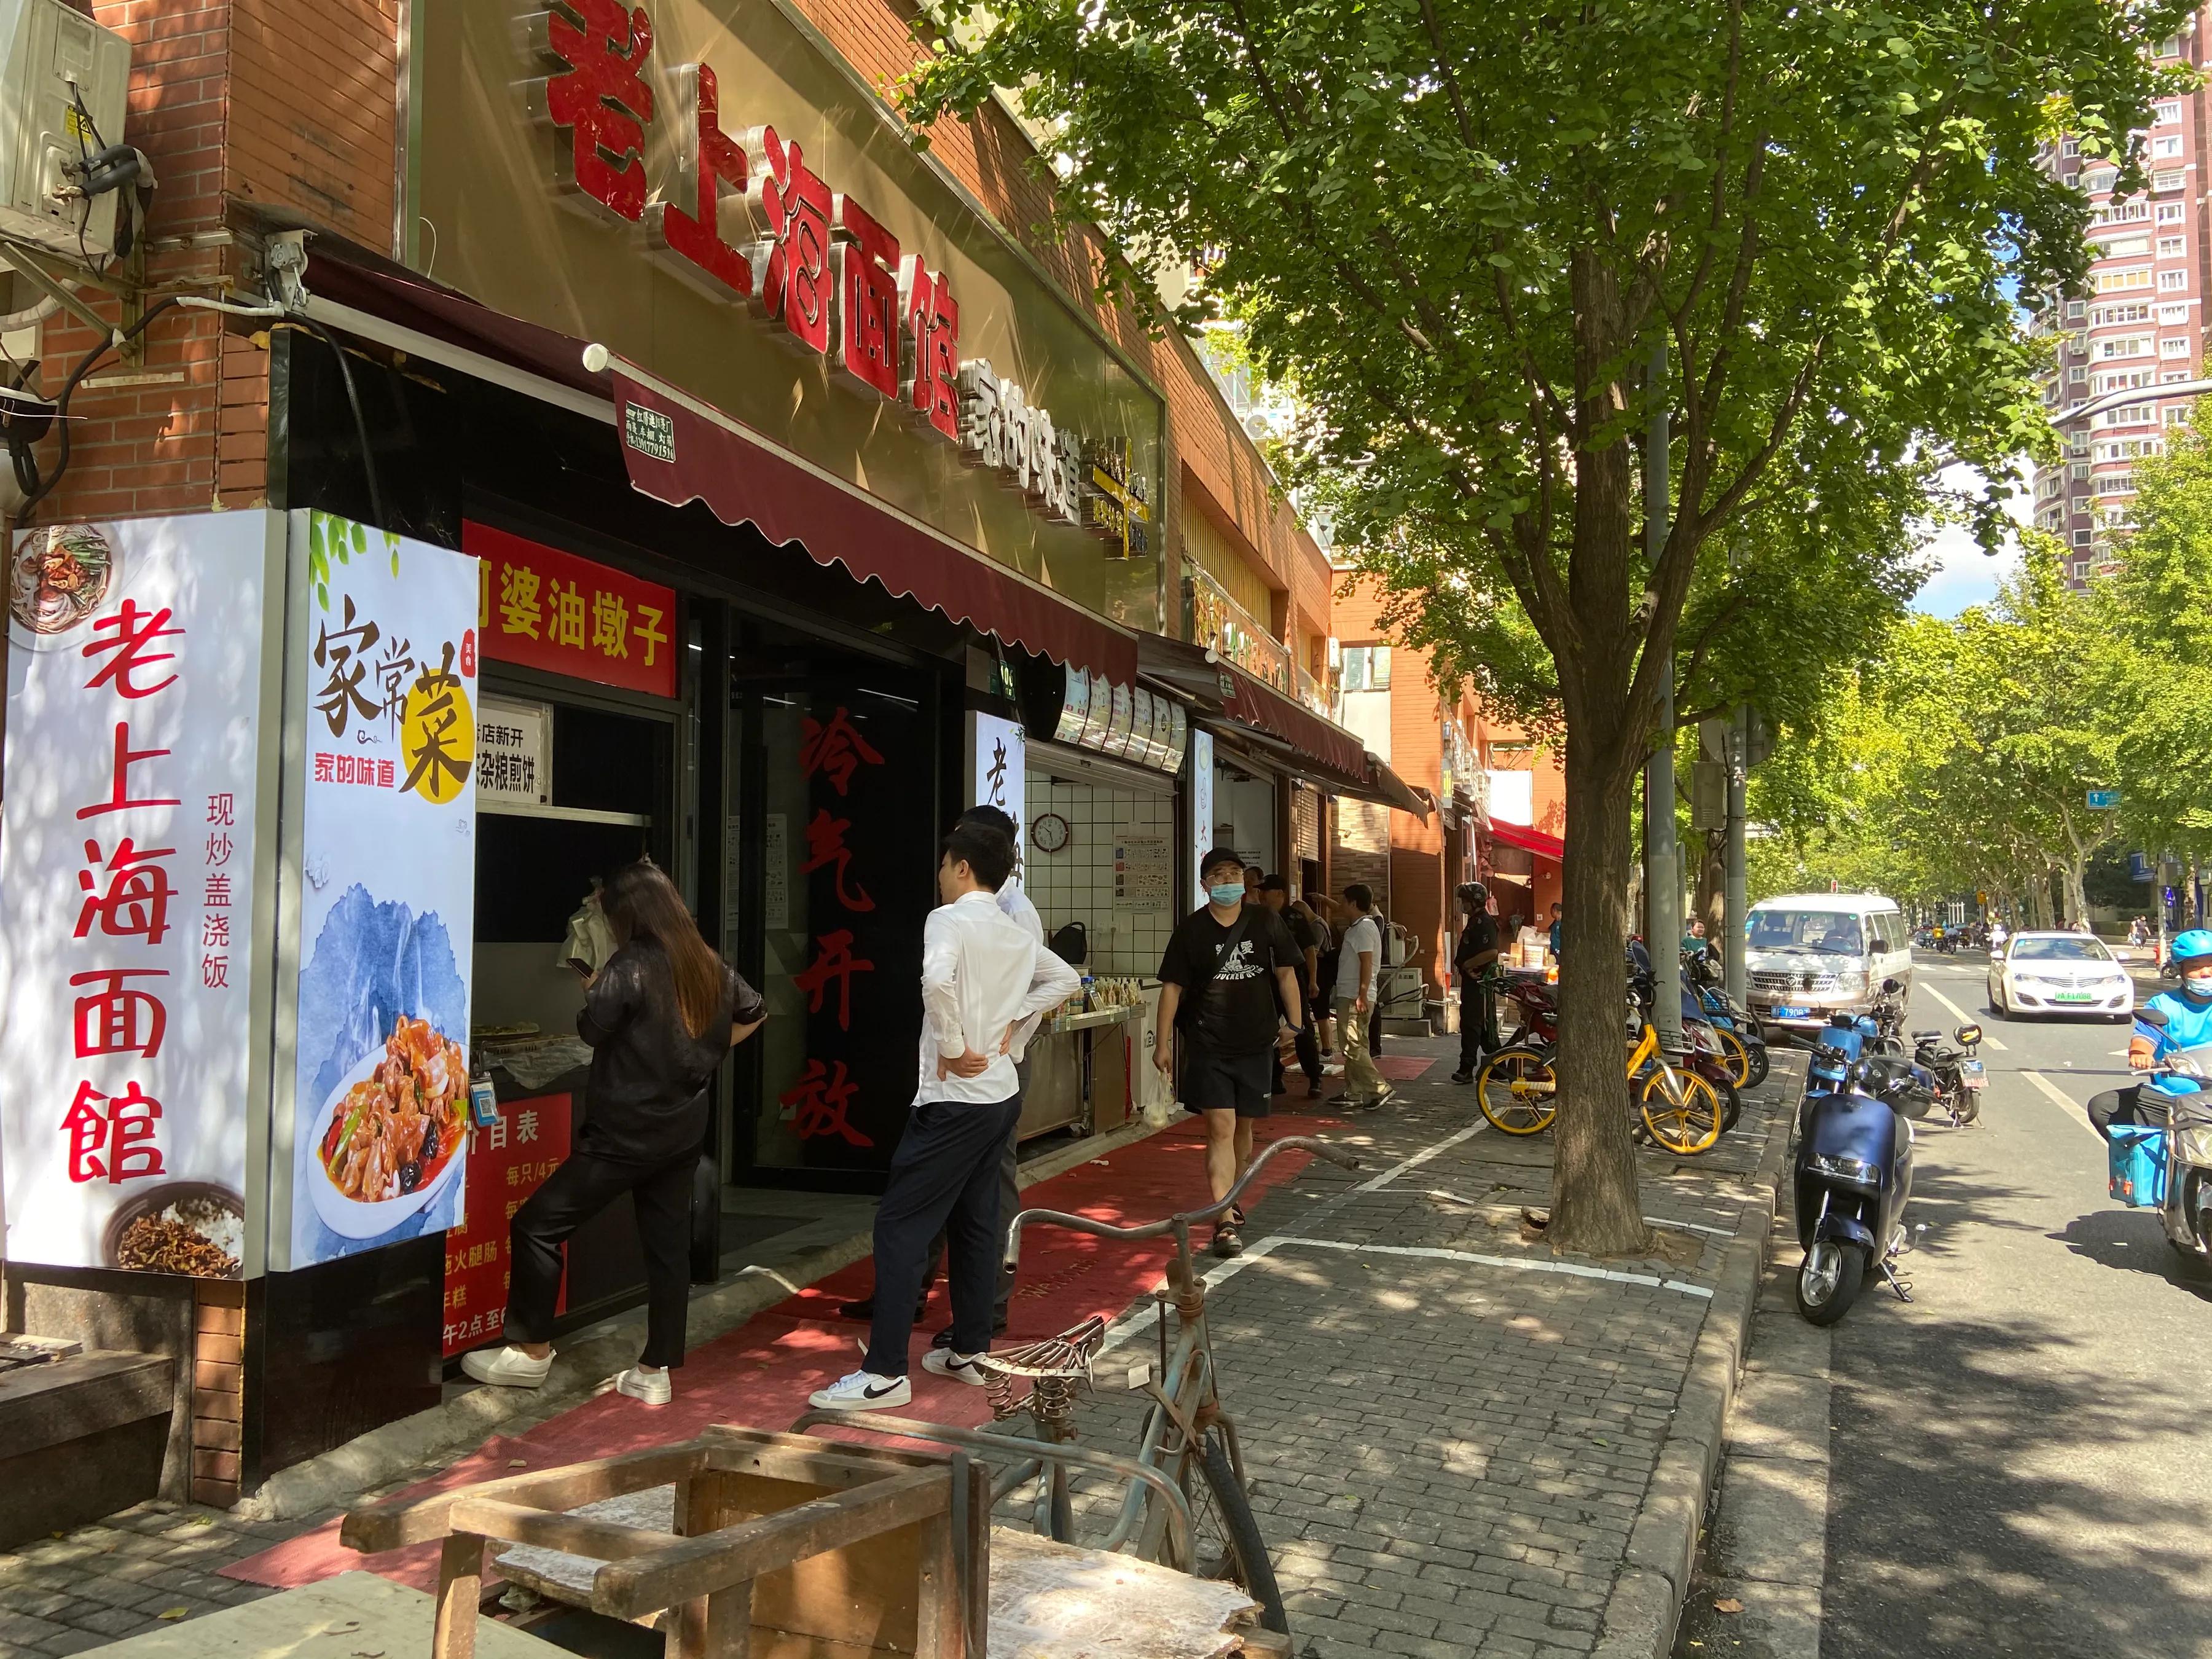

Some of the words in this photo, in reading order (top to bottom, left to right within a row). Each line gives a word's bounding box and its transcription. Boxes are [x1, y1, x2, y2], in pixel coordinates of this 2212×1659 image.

[314, 593, 474, 797] 家常菜
[314, 753, 395, 789] 家的味道
[477, 723, 524, 748] 店新开
[477, 749, 535, 794] 杂粮煎饼
[60, 598, 187, 1185] 老上海面館
[201, 793, 235, 989] 现炒盖浇饭
[779, 707, 886, 1148] 冷气开放
